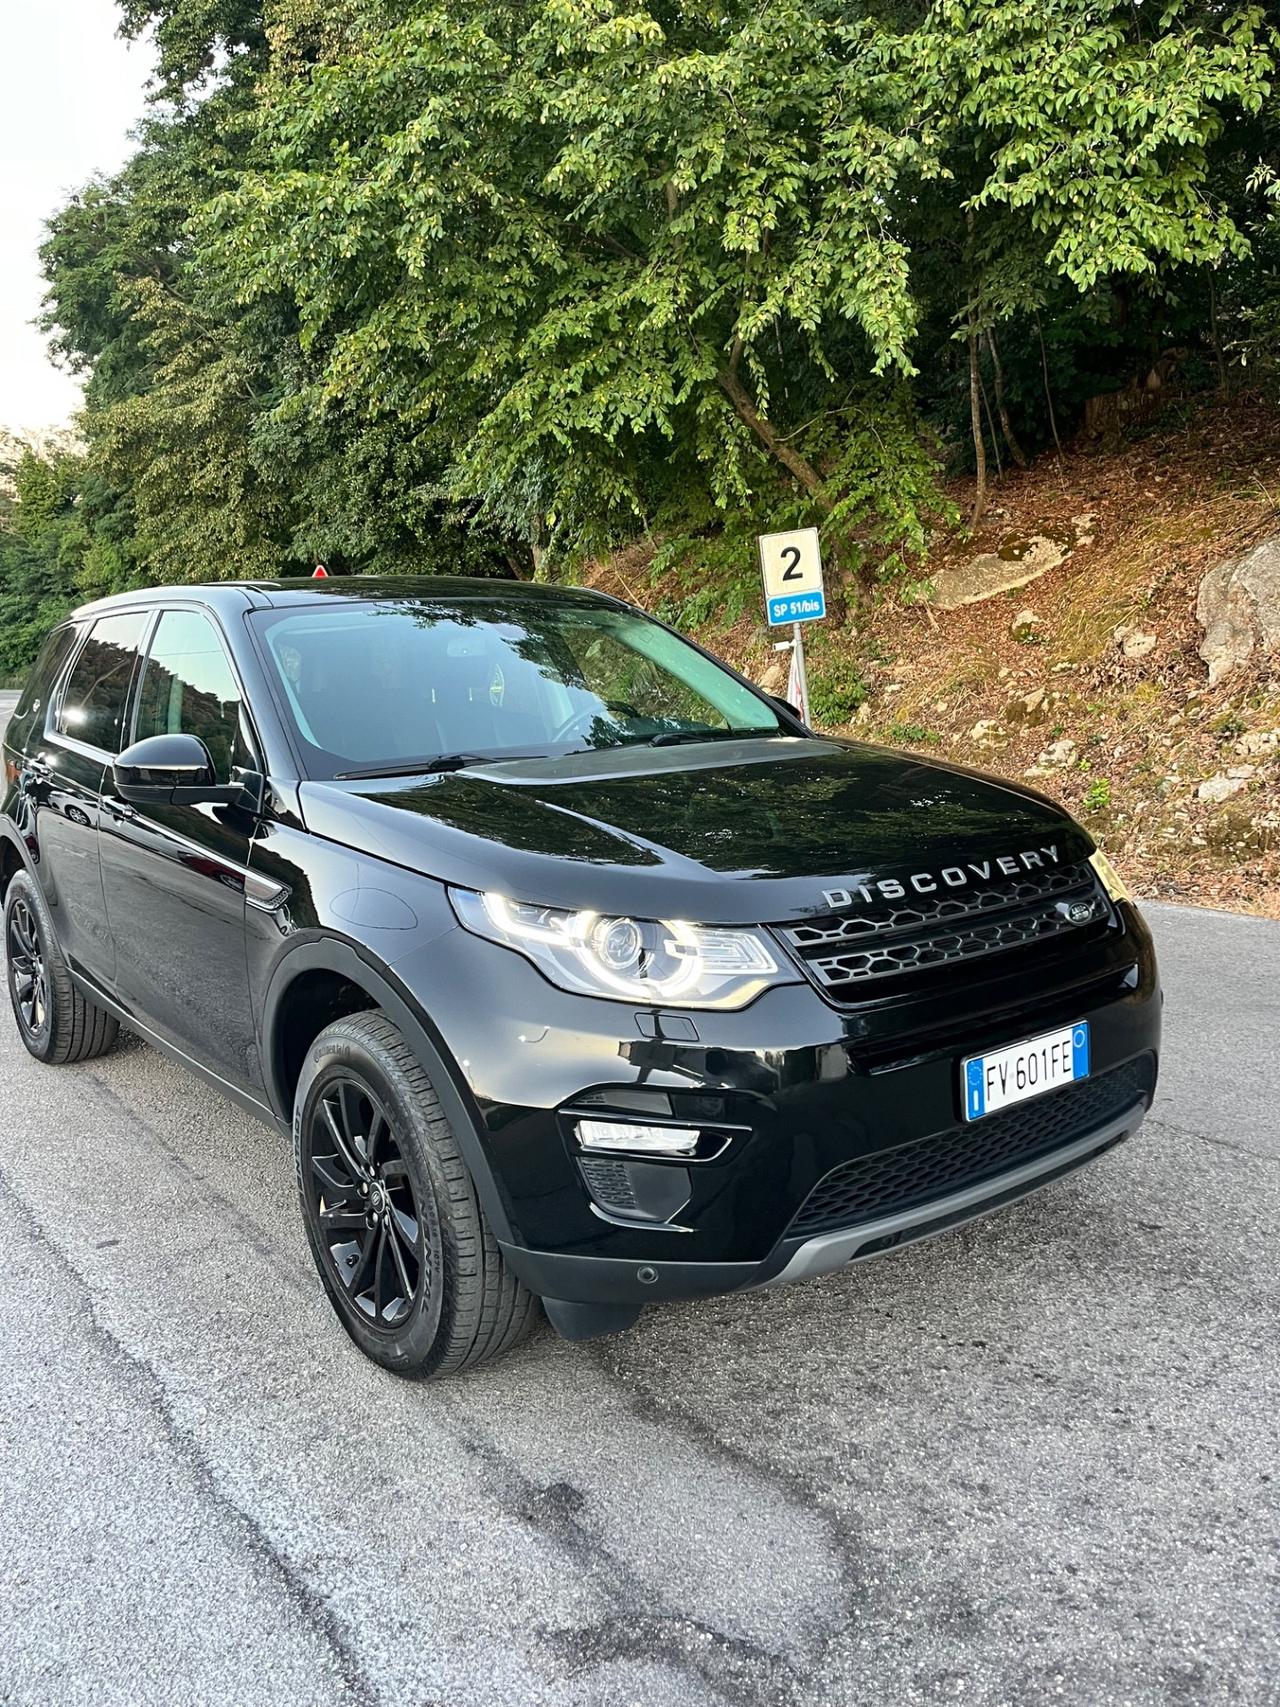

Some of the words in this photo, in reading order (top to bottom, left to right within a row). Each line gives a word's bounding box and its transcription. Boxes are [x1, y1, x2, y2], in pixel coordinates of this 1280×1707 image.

[780, 546, 803, 581] 2
[773, 603, 788, 618] SP
[790, 599, 820, 615] 51/bis
[821, 845, 1060, 908] DISCOVERY
